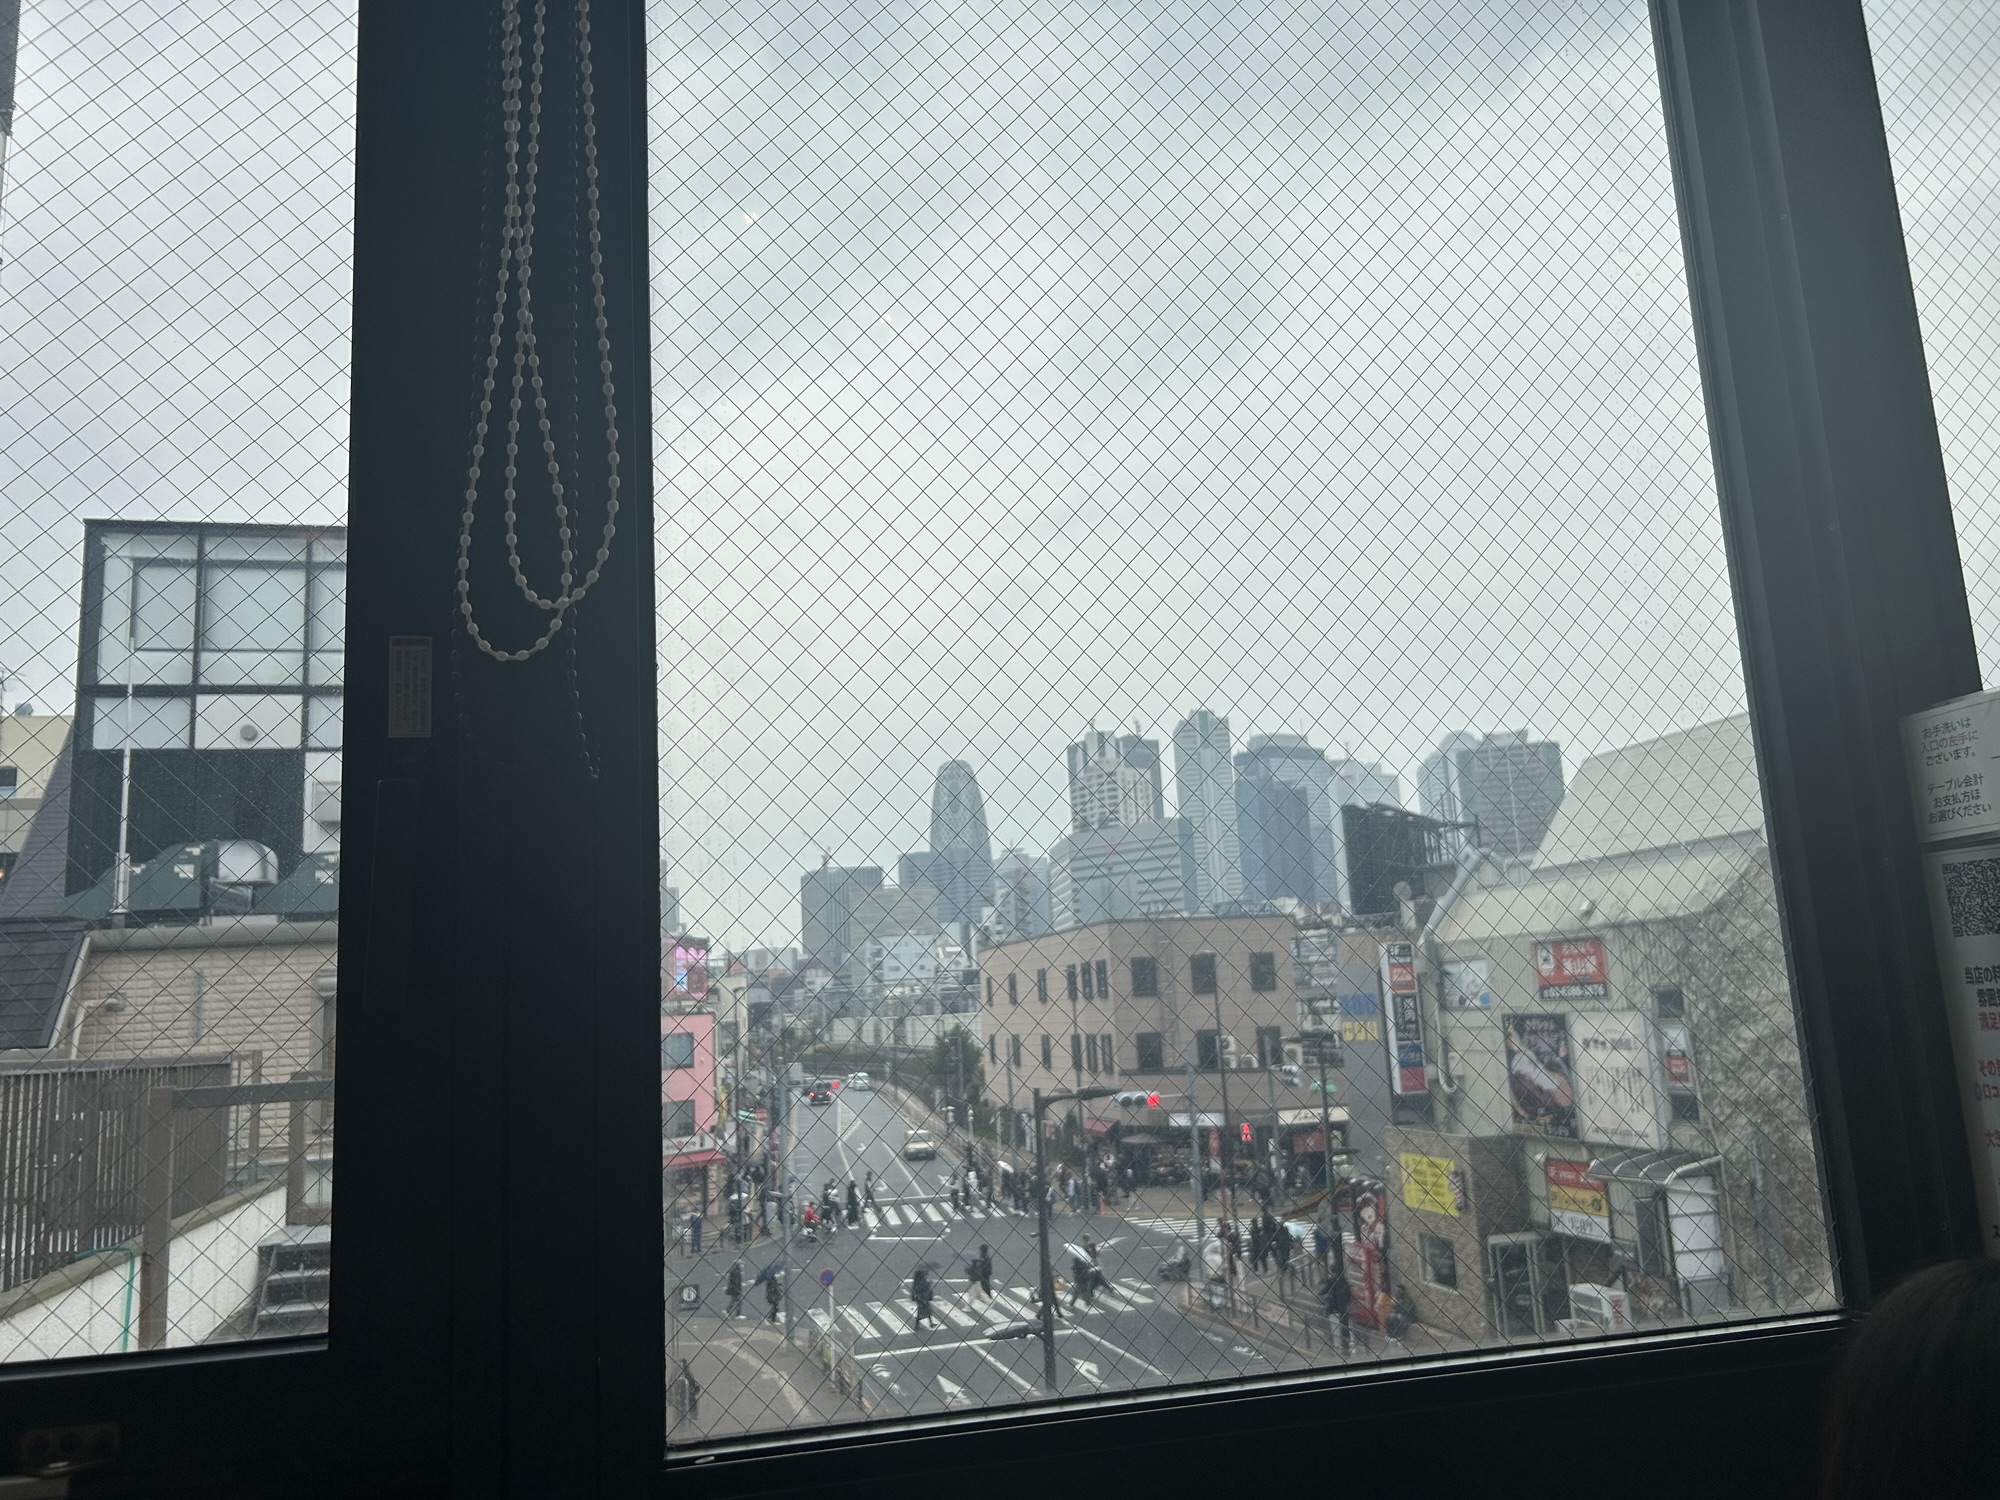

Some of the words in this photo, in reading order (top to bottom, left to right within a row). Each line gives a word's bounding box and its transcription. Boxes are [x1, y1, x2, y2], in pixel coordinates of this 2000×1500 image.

[1922, 716, 1972, 739] お手洗いは
[1921, 730, 1980, 754] 入口の左手に
[1926, 745, 1976, 767] ございます。
[1927, 773, 1984, 796] テーブル会計
[1928, 803, 1992, 825] お選びください
[1978, 1011, 2000, 1031] 満足
